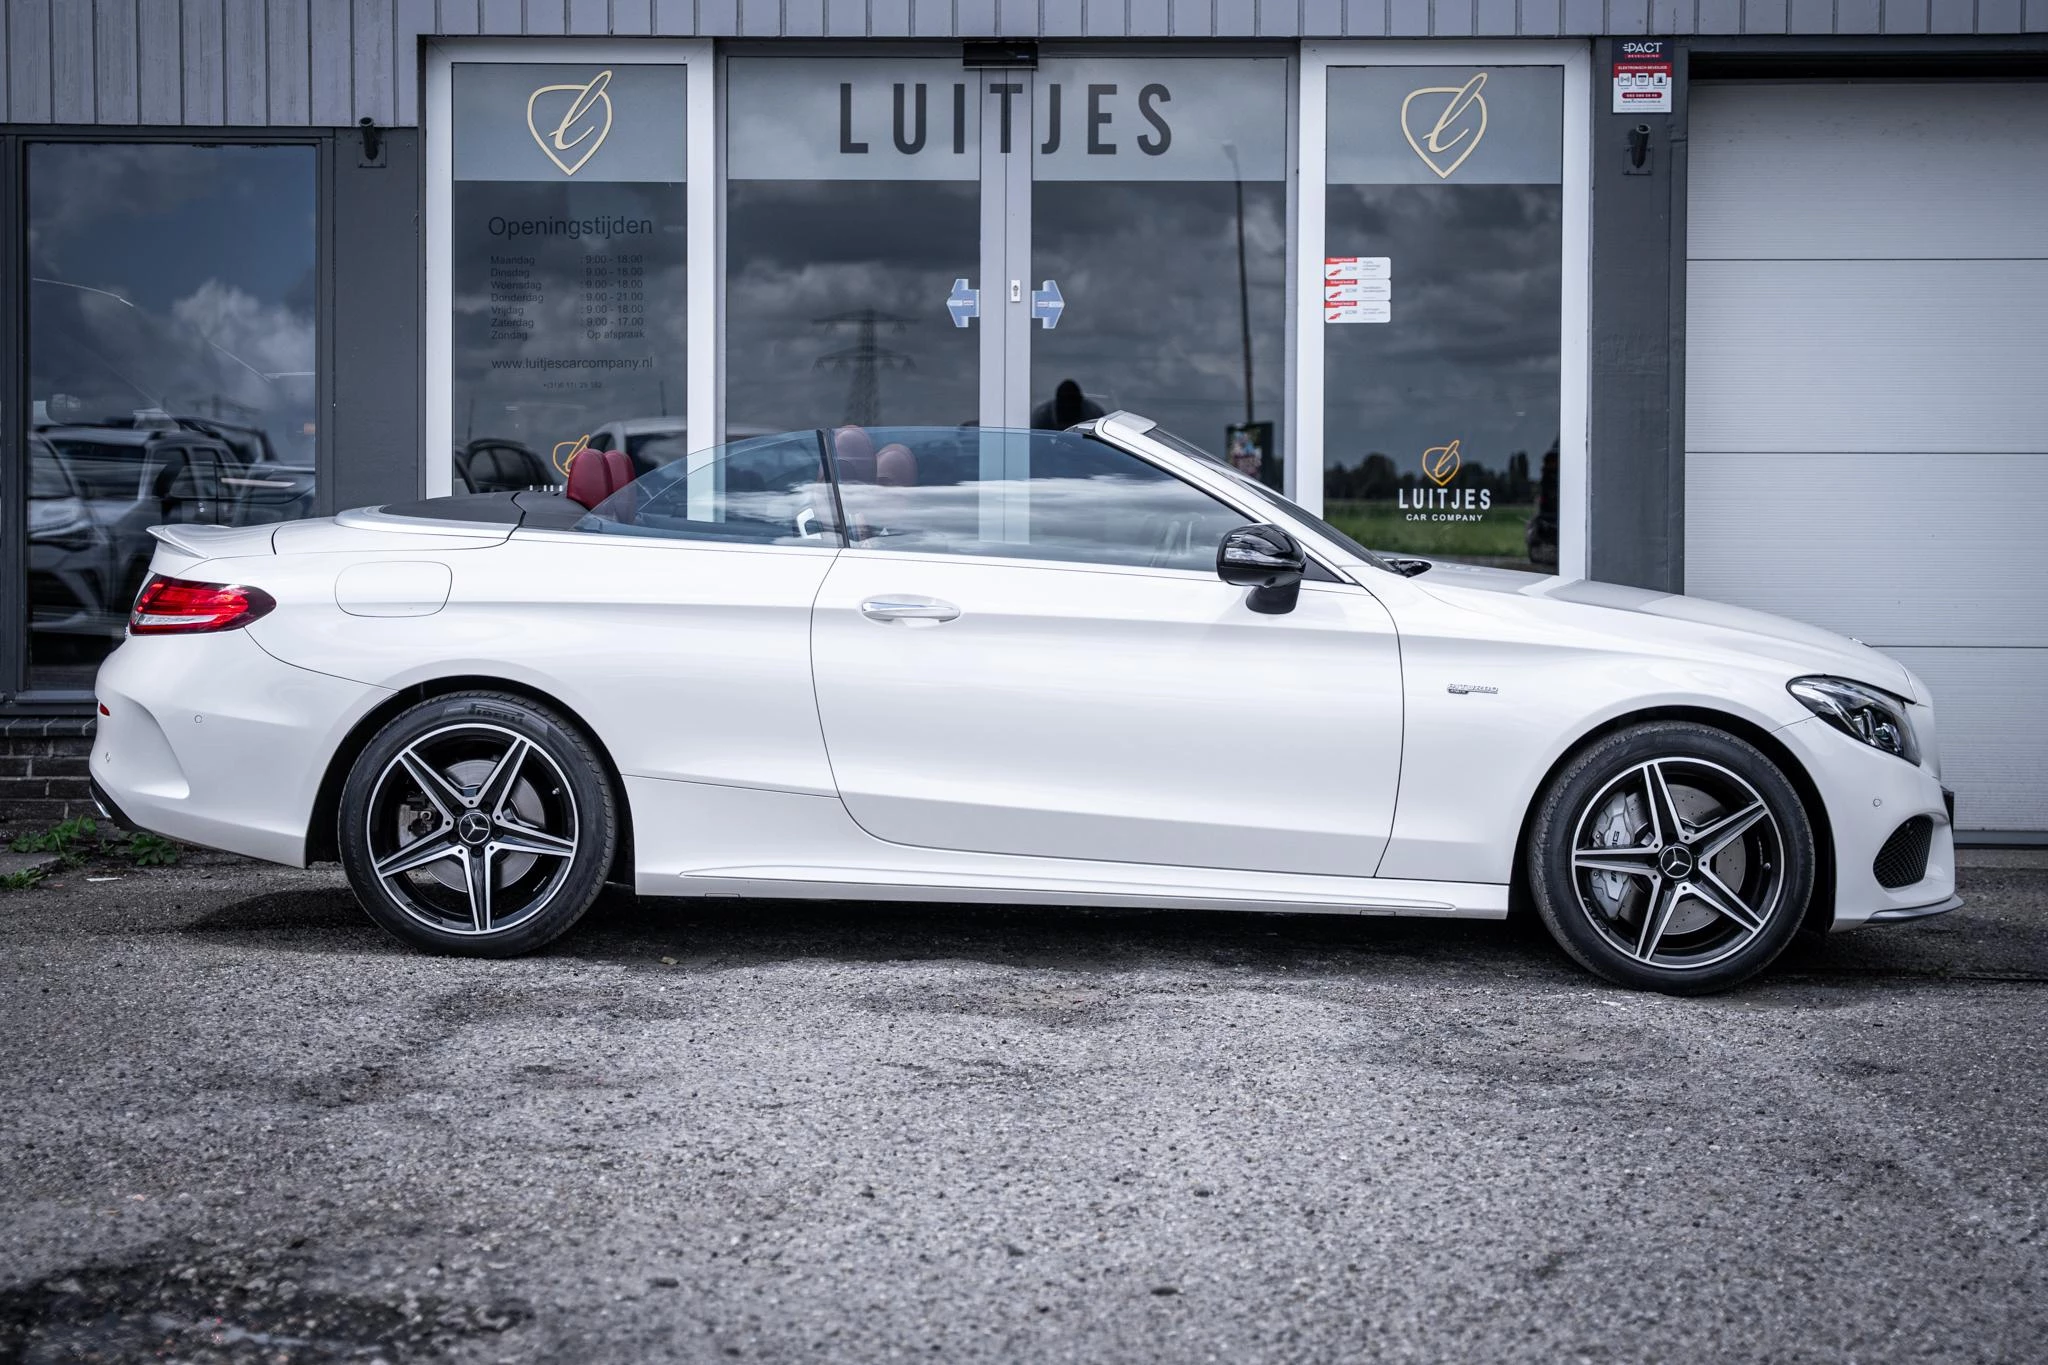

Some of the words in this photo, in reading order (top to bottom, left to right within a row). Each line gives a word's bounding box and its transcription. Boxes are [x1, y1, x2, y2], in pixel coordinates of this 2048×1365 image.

[1626, 42, 1663, 53] PACT
[840, 83, 1172, 156] LUITJES
[488, 215, 653, 240] Openingstijden
[490, 256, 535, 266] Maandag
[490, 268, 530, 278] Dinsdag
[490, 280, 542, 291] Woensdag
[491, 293, 544, 304] Donderdag
[491, 306, 524, 316] Vrijdag
[491, 318, 534, 328] Zaterdag
[491, 330, 528, 341] Zondag
[586, 330, 601, 340] Op
[603, 329, 645, 340] afspraak
[491, 357, 653, 371] www.luitjescarcompany.nl
[1399, 488, 1491, 510] LUITJES
[1406, 513, 1427, 521] CAR
[1431, 513, 1483, 521] COMPANY
